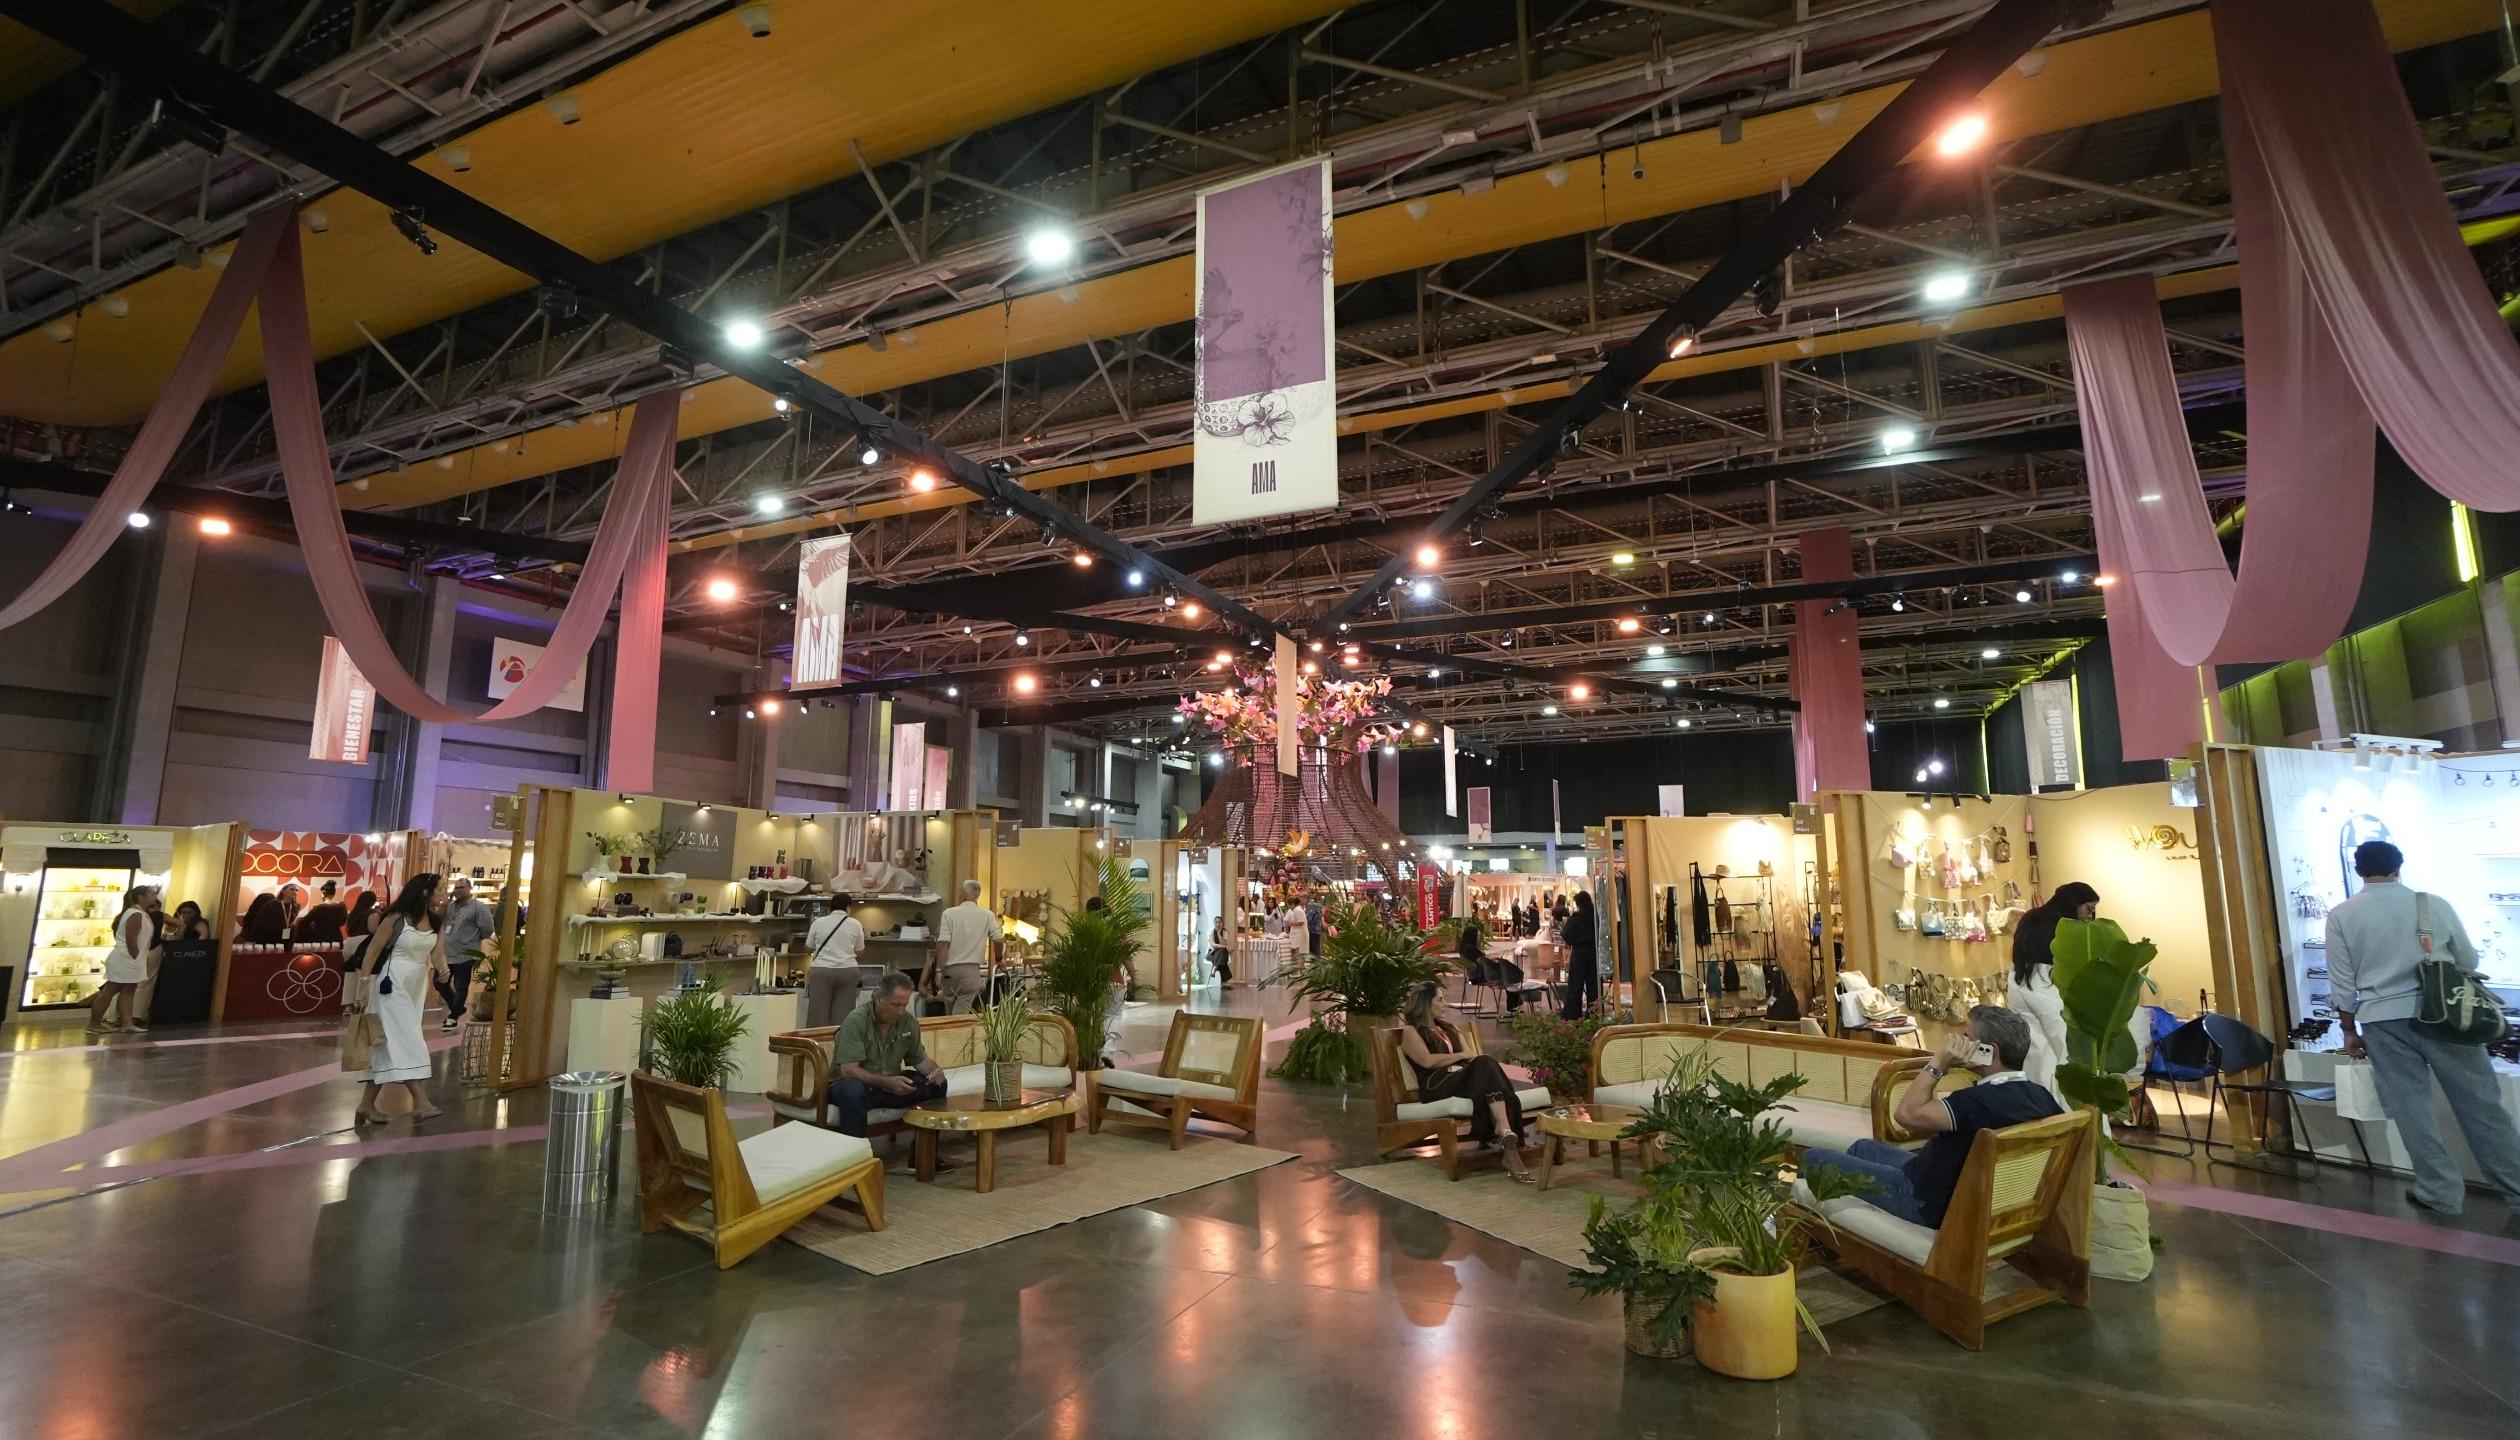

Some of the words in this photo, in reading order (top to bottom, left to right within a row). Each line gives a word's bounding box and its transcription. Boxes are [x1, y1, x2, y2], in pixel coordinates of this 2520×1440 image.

[1251, 460, 1277, 495] AMA
[797, 613, 841, 684] AMA
[342, 688, 366, 761] BIENESTAR
[2046, 708, 2070, 782] DECORACIÓN
[59, 831, 132, 844] CLAREZA
[677, 830, 720, 847] ZEMA
[173, 950, 208, 959] CLAREZA
